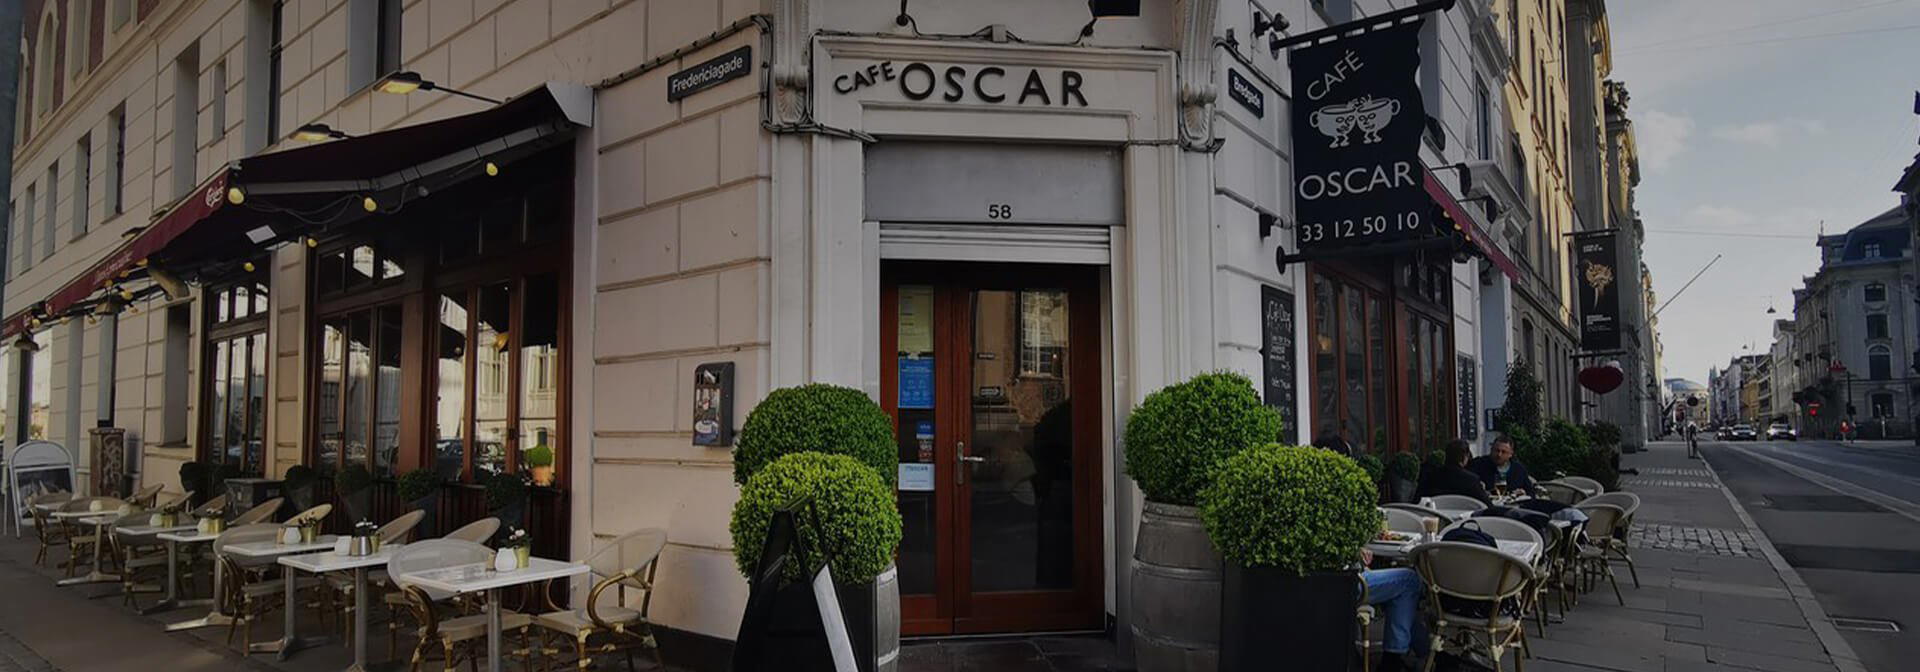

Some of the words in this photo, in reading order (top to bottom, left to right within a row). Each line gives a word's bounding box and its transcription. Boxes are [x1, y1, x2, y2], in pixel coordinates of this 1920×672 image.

[672, 56, 743, 93] Fredericiagade
[901, 63, 1088, 106] OSCAR
[1307, 50, 1364, 101] CAFÉ
[1299, 161, 1416, 200] OSCAR
[988, 204, 1012, 219] 58
[1301, 223, 1324, 242] 33
[1335, 219, 1355, 238] 12
[1362, 215, 1387, 235] 50
[1398, 211, 1420, 231] 10
